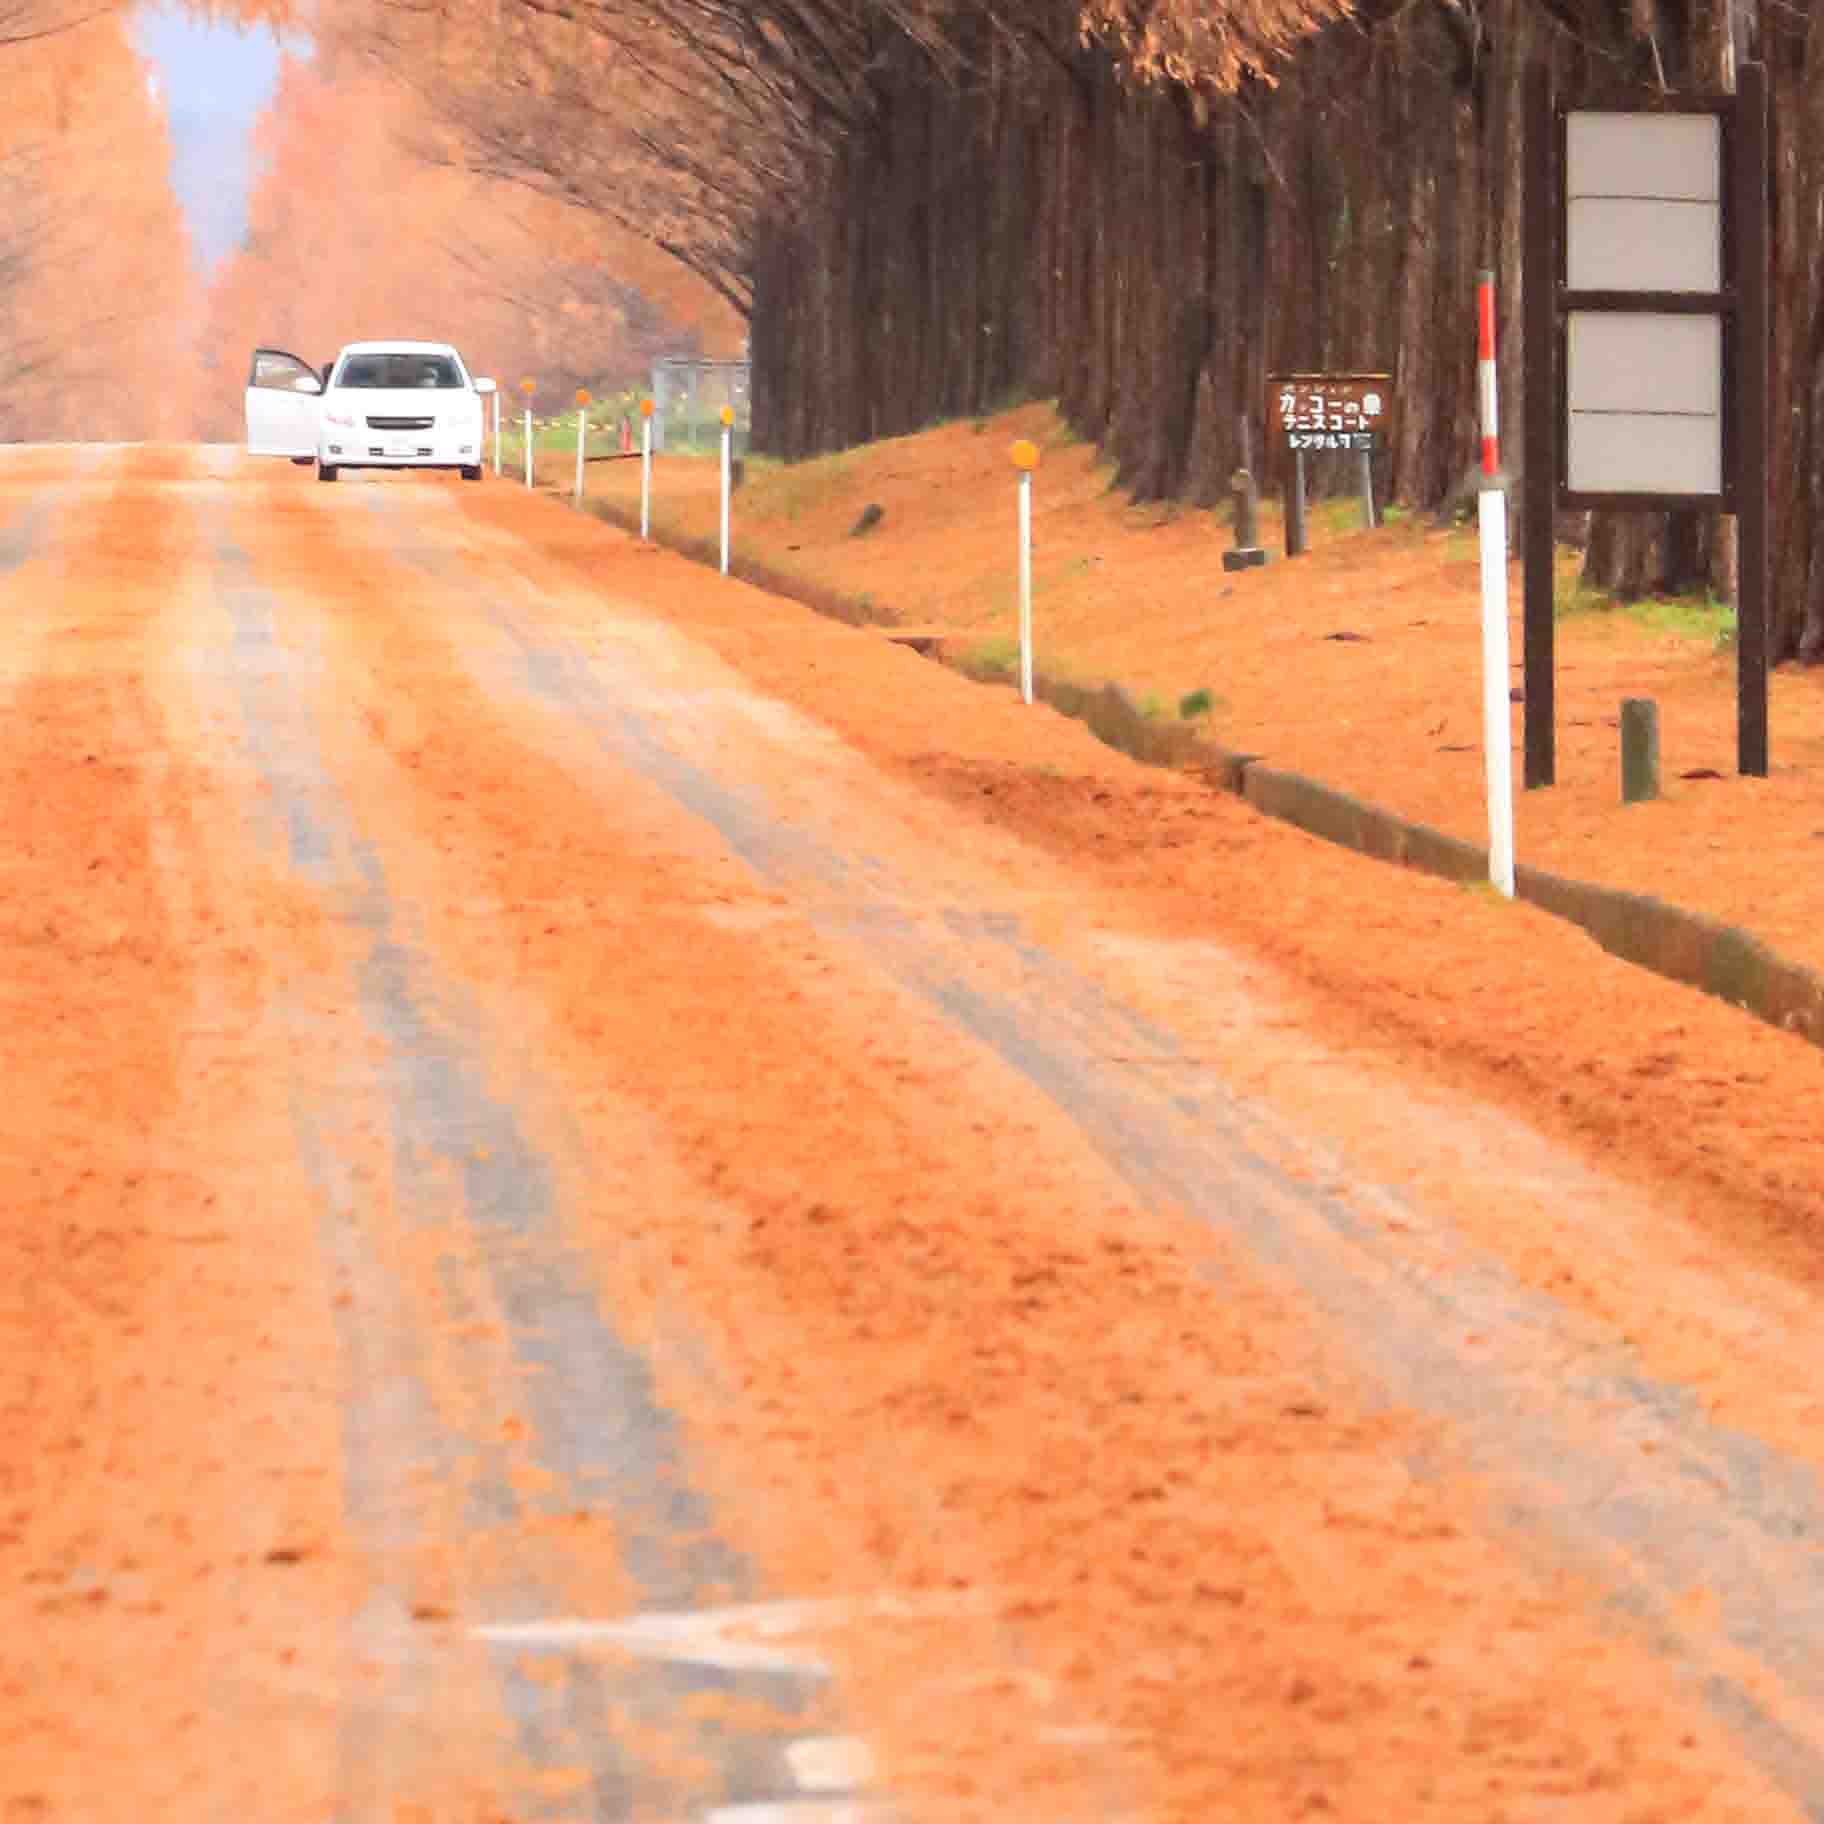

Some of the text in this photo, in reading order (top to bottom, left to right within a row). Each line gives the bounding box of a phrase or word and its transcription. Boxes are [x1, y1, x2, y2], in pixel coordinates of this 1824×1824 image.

[1283, 414, 1370, 431] テニスコート
